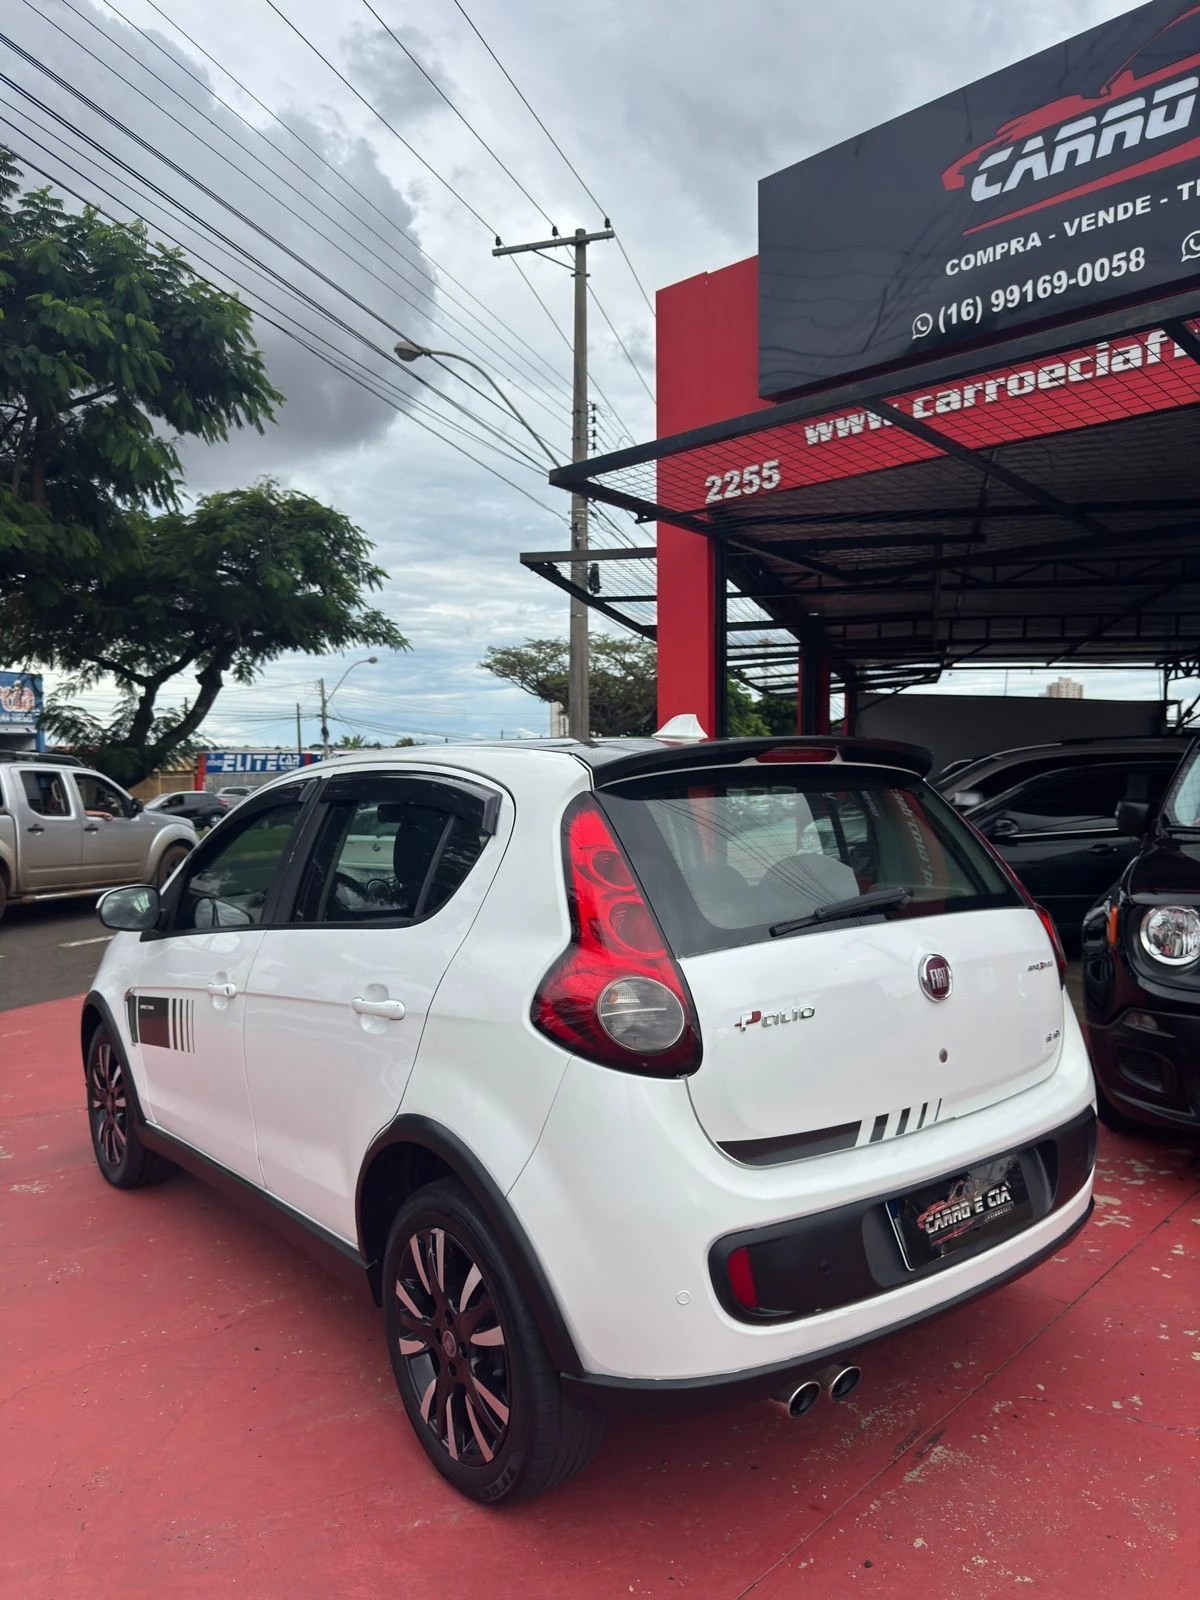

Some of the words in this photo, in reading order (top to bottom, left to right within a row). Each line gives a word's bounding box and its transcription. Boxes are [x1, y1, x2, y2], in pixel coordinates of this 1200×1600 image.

[970, 75, 1199, 202] CARRO
[945, 231, 1042, 276] COMPRA
[1063, 195, 1152, 238] VENDE
[938, 297, 983, 334] (16)
[991, 246, 1146, 313] 99169-0058
[704, 459, 781, 504] 2255
[221, 754, 278, 771] ELITE
[929, 967, 949, 989] FIAT
[735, 1003, 816, 1032] Palio
[924, 1199, 971, 1233] CARRO
[974, 1195, 984, 1213] E
[987, 1186, 1012, 1208] CIA
